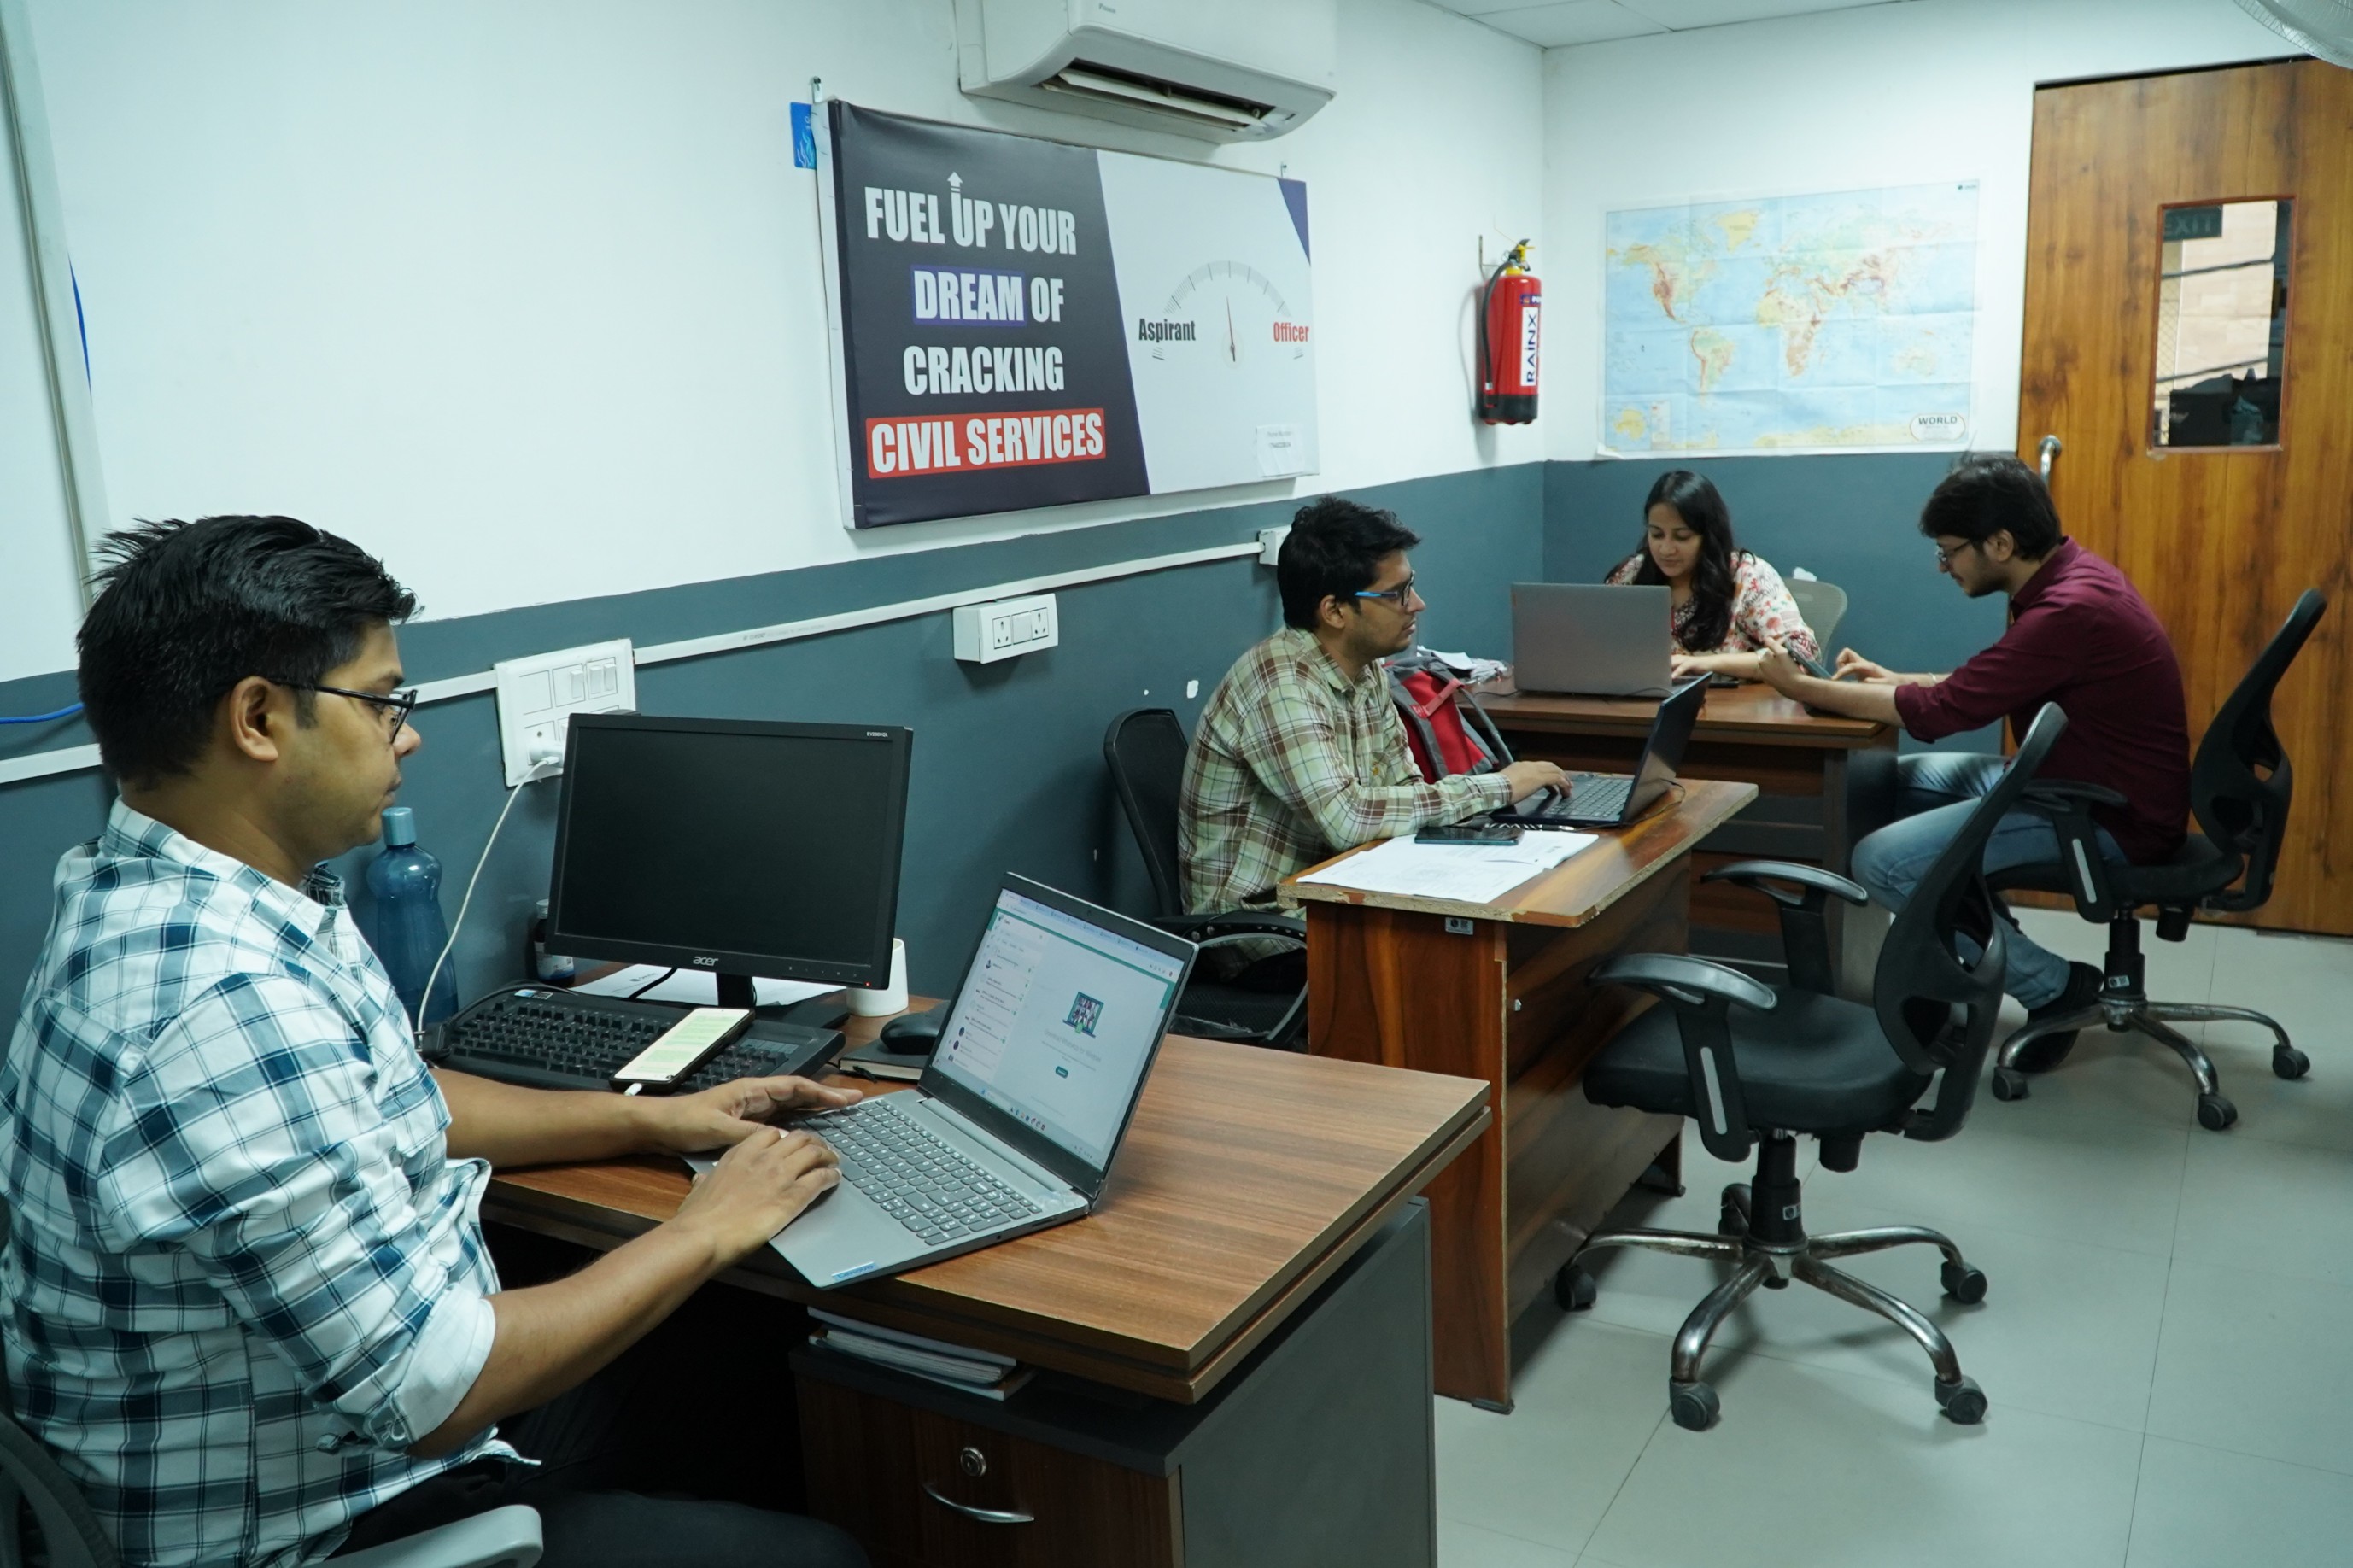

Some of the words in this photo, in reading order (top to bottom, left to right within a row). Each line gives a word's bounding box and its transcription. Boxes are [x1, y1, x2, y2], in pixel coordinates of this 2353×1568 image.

[864, 186, 945, 244] FUEL
[950, 191, 994, 248] UP
[998, 203, 1077, 255] YOUR
[913, 270, 1025, 321] DREAM
[1030, 277, 1064, 322] OF
[1138, 318, 1197, 343] Aspirant
[1273, 321, 1309, 342] Officer
[903, 345, 1065, 395] CRACKING
[1918, 416, 1958, 425] WORLD
[871, 421, 962, 473] CIVIL
[966, 412, 1103, 465] SERVICES
[693, 956, 719, 967] acer
